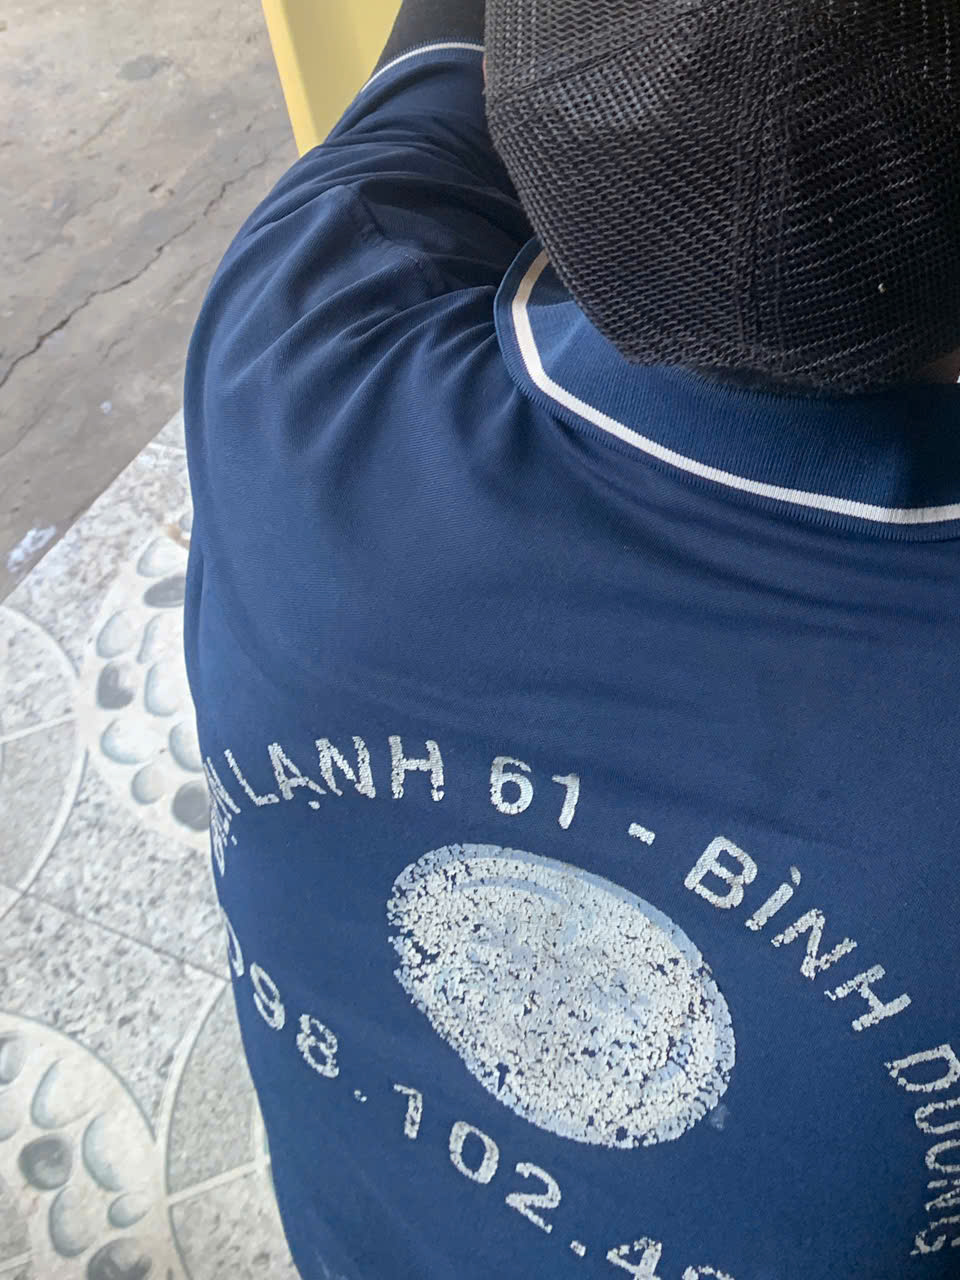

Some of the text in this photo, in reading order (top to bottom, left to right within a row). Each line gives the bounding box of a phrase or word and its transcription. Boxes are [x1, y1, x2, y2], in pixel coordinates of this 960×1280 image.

[224, 735, 445, 810] LẠNH
[489, 755, 580, 829] 61
[684, 836, 911, 1031] BÌNH
